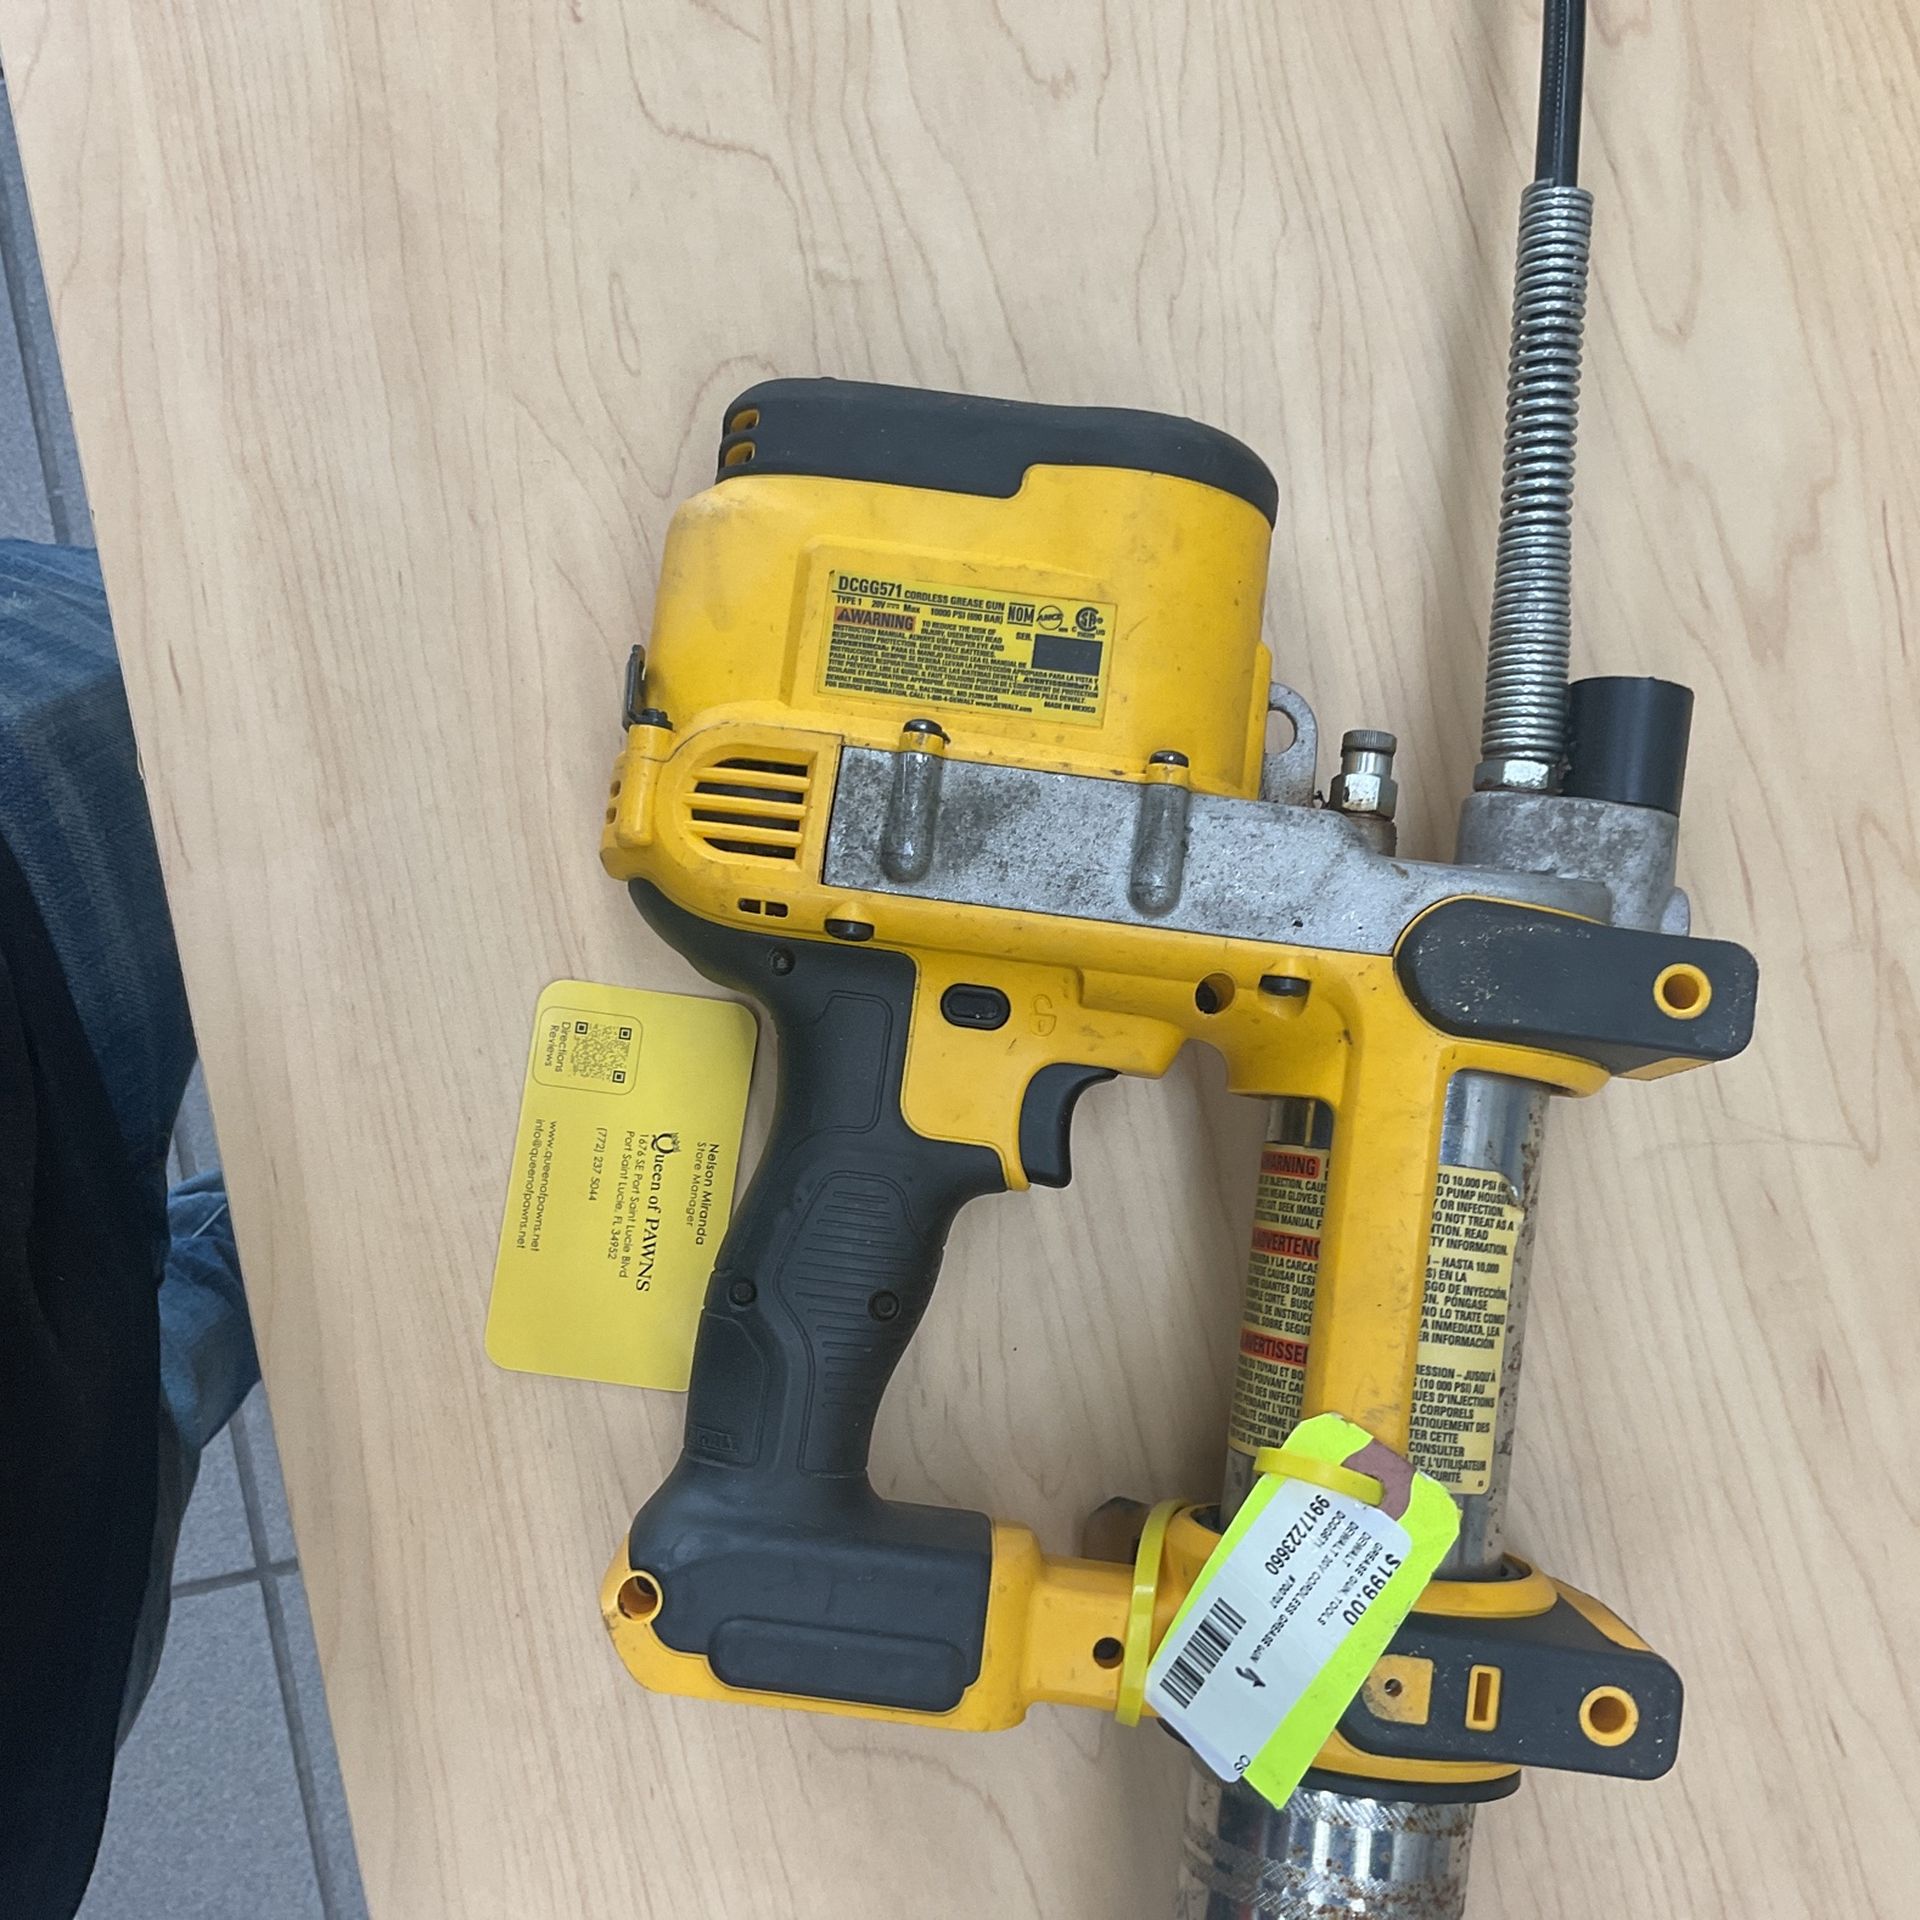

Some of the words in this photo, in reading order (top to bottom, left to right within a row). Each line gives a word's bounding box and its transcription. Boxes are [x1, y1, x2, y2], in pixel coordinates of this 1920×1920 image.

[836, 595, 855, 604] TYPE
[857, 597, 861, 605] 1
[838, 576, 901, 597] DCGG571
[904, 590, 948, 603] CORDLESS
[950, 595, 983, 608] GREASE
[985, 599, 1004, 610] GUN
[851, 608, 914, 630] WARNING
[1007, 605, 1034, 623] NOM
[543, 1024, 559, 1067] Reviews
[553, 1021, 571, 1073] Directions
[592, 1126, 608, 1153] (772)
[622, 1130, 635, 1151] Port
[636, 1133, 650, 1157] 1676
[591, 1155, 603, 1174] 237
[618, 1153, 632, 1179] Saint
[634, 1158, 645, 1171] SE
[644, 1131, 679, 1192] Queen
[692, 1141, 707, 1171] Store
[702, 1143, 720, 1187] Nelson
[515, 1118, 545, 1249] info@queenofpawns.net
[528, 1120, 559, 1251] www.queenofpawns.net
[586, 1176, 600, 1201] 5044
[630, 1173, 644, 1194] Port
[1451, 1175, 1480, 1188] 10,000
[1481, 1179, 1496, 1190] PSI
[646, 1195, 664, 1211] of
[683, 1173, 703, 1227] Manager
[1287, 1190, 1318, 1204] GLOVES
[1445, 1187, 1476, 1200] PUMP
[626, 1195, 640, 1222] Saint
[692, 1190, 714, 1246] Miranda
[1439, 1199, 1454, 1210] OR
[1456, 1201, 1504, 1216] INFECTION.
[611, 1215, 623, 1227] FL
[1280, 1214, 1315, 1229] MANUAL
[1444, 1212, 1466, 1224] NOT
[1467, 1215, 1494, 1228] TREAT
[1495, 1219, 1506, 1230] AS
[1506, 1220, 1514, 1231] A
[606, 1228, 621, 1259] 34952
[621, 1224, 635, 1252] Lucie
[1464, 1228, 1488, 1239] READ
[633, 1217, 661, 1292] PAWNS
[1445, 1238, 1508, 1255] INFORMATION.
[617, 1255, 631, 1278] Blvd
[1275, 1256, 1284, 1267] LA
[1441, 1257, 1474, 1270] HASTA
[1438, 1269, 1452, 1280] EN
[1454, 1271, 1468, 1282] LA
[1447, 1283, 1461, 1294] DE
[1439, 1307, 1452, 1318] LO
[1454, 1309, 1481, 1322] TRATE
[1482, 1312, 1505, 1324] COMO
[1431, 1320, 1485, 1335] INMEDIATA.
[1279, 1366, 1289, 1377] ET
[1418, 1378, 1434, 1389] (10
[1436, 1380, 1452, 1391] 000
[1472, 1383, 1485, 1394] AU
[1436, 1392, 1495, 1408] D'INJECTIONS
[1419, 1404, 1474, 1418] CORPORELS
[1429, 1431, 1458, 1443] CETTE
[1475, 1421, 1490, 1433] DES
[1407, 1441, 1465, 1456] CONSULTER
[1412, 1455, 1425, 1465] DE
[1262, 1492, 1331, 1578] 9917223660
[1312, 1509, 1346, 1550] DCGG571
[1327, 1519, 1359, 1557] DEWALT
[1340, 1530, 1371, 1568] DEWALT
[1353, 1540, 1384, 1577] GREASE
[1267, 1573, 1296, 1609] #700707
[1283, 1569, 1321, 1617] CORDLESS
[1340, 1550, 1402, 1627] $199.00
[1316, 1594, 1342, 1626] TOOLS
[1260, 1611, 1289, 1648] GREASE
[1248, 1643, 1266, 1663] GUN
